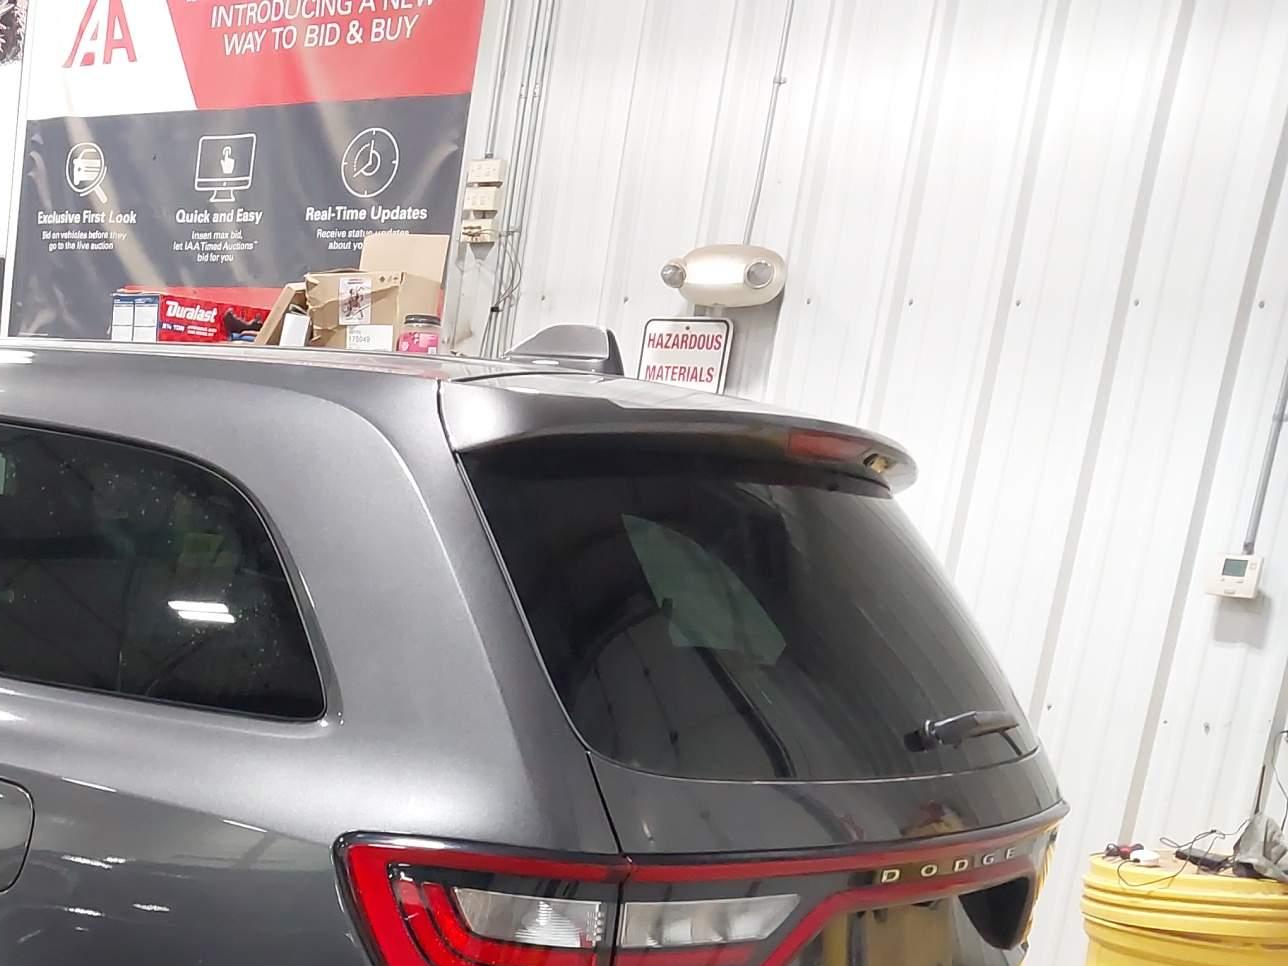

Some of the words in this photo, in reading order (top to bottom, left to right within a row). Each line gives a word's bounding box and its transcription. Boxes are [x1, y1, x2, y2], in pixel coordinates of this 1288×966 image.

[211, 0, 352, 28] INTRODUCING
[223, 27, 268, 57] WAY
[271, 25, 297, 50] TO
[303, 22, 341, 48] BID
[346, 19, 363, 44] &
[370, 15, 419, 42] BUY
[37, 210, 81, 224] Exclusive
[82, 209, 107, 223] First
[108, 209, 137, 224] Look
[175, 209, 210, 224] Quick
[212, 209, 234, 224] and
[236, 208, 263, 225] Easy
[305, 206, 367, 221] Real-Time
[370, 205, 428, 223] Updates
[42, 231, 51, 240] Bid
[60, 231, 88, 240] vehicles
[88, 230, 109, 240] before
[109, 230, 128, 241] they
[213, 232, 230, 240] max
[316, 228, 347, 238] Receive
[48, 242, 58, 252] go
[57, 241, 65, 250] to
[65, 241, 76, 250] the
[77, 241, 90, 250] live
[90, 241, 114, 250] auction
[173, 241, 183, 251] let
[184, 241, 200, 251] IAA
[200, 241, 222, 251] Timed
[328, 241, 352, 250] about
[197, 252, 208, 262] bid
[209, 252, 219, 262] for
[220, 254, 234, 264] you
[165, 300, 218, 323] Duralast
[647, 333, 723, 350] HAZARDOUS
[645, 365, 715, 383] MATERIALS
[881, 848, 1016, 883] DODGE
